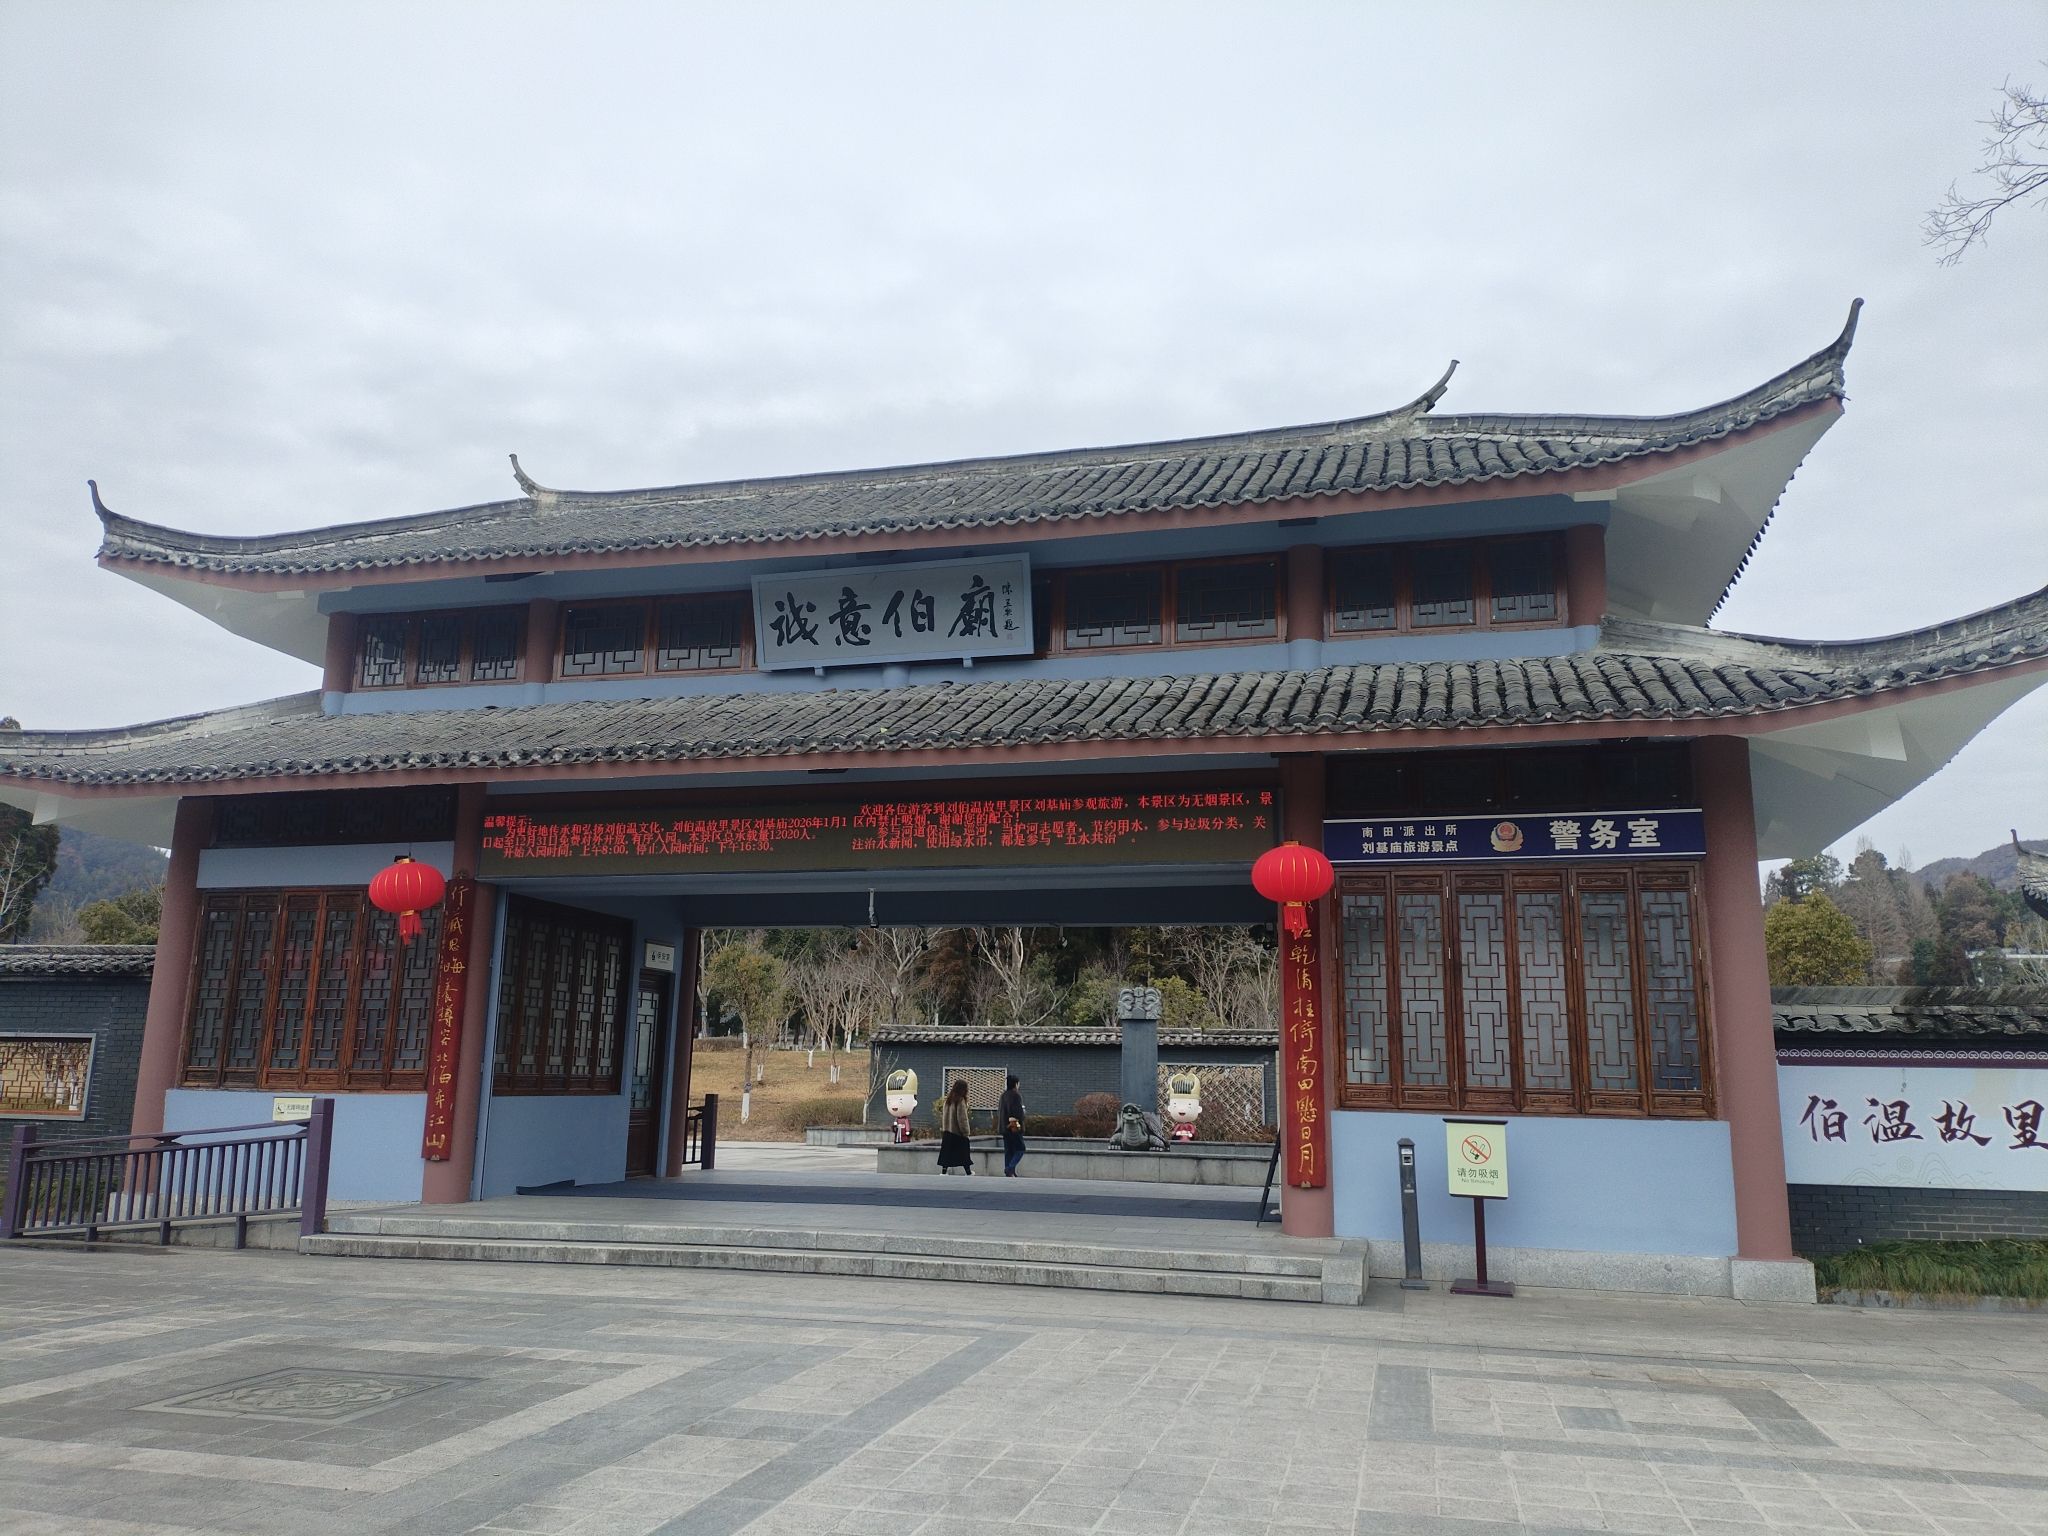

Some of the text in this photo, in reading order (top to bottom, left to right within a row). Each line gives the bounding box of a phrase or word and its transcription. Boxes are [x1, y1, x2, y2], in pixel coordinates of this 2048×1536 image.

[1362, 824, 1457, 838] 南田派出所
[1549, 818, 1661, 850] 警务室
[1362, 840, 1458, 854] 刘基庙旅游景点
[1800, 1095, 2048, 1150] 伯温故里
[1457, 1167, 1499, 1179] 请勿吸烟
